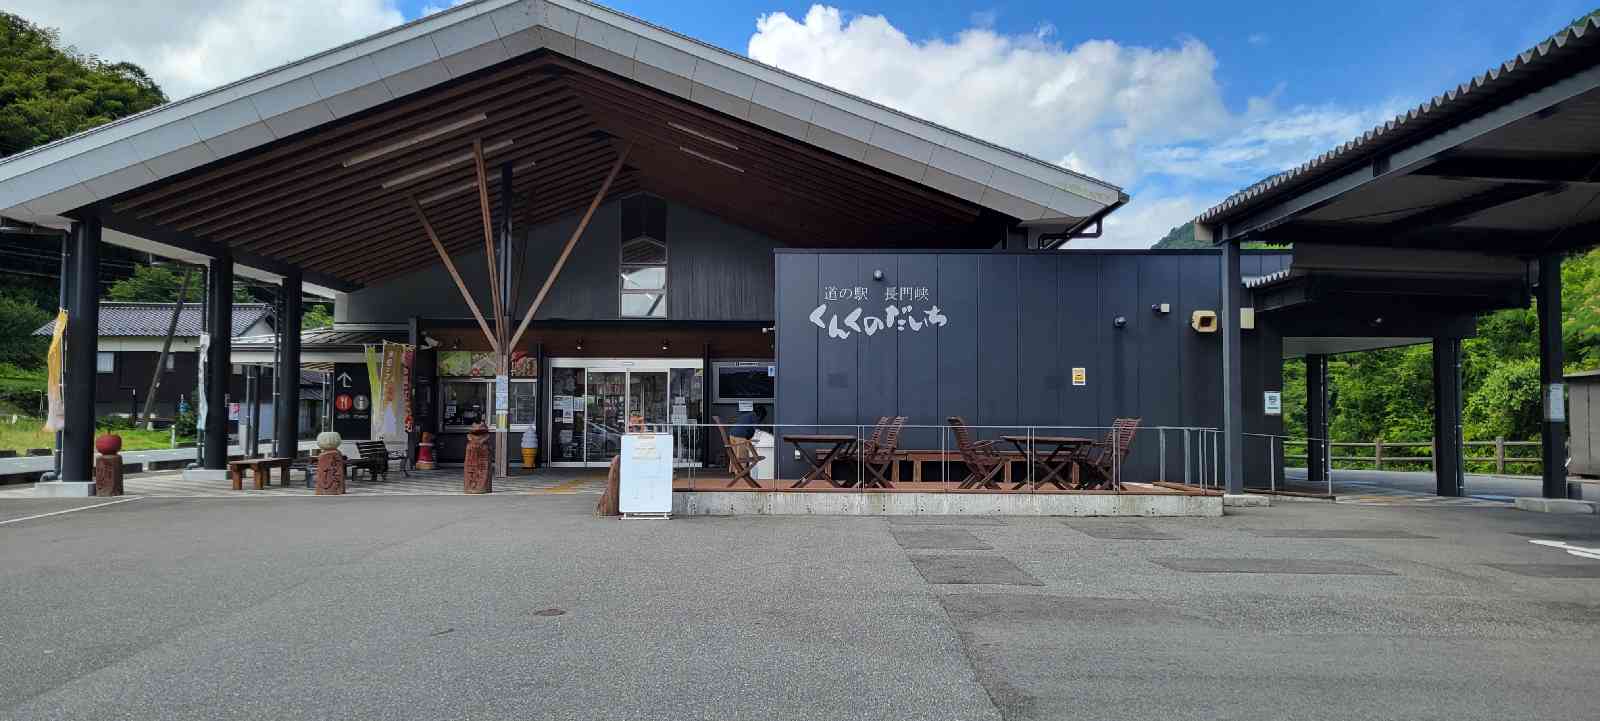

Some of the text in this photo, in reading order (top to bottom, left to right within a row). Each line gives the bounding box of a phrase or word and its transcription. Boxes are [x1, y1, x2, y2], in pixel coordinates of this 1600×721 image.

[824, 286, 929, 301] 道の駅 長門峡
[809, 303, 948, 339] くんくのだいち
